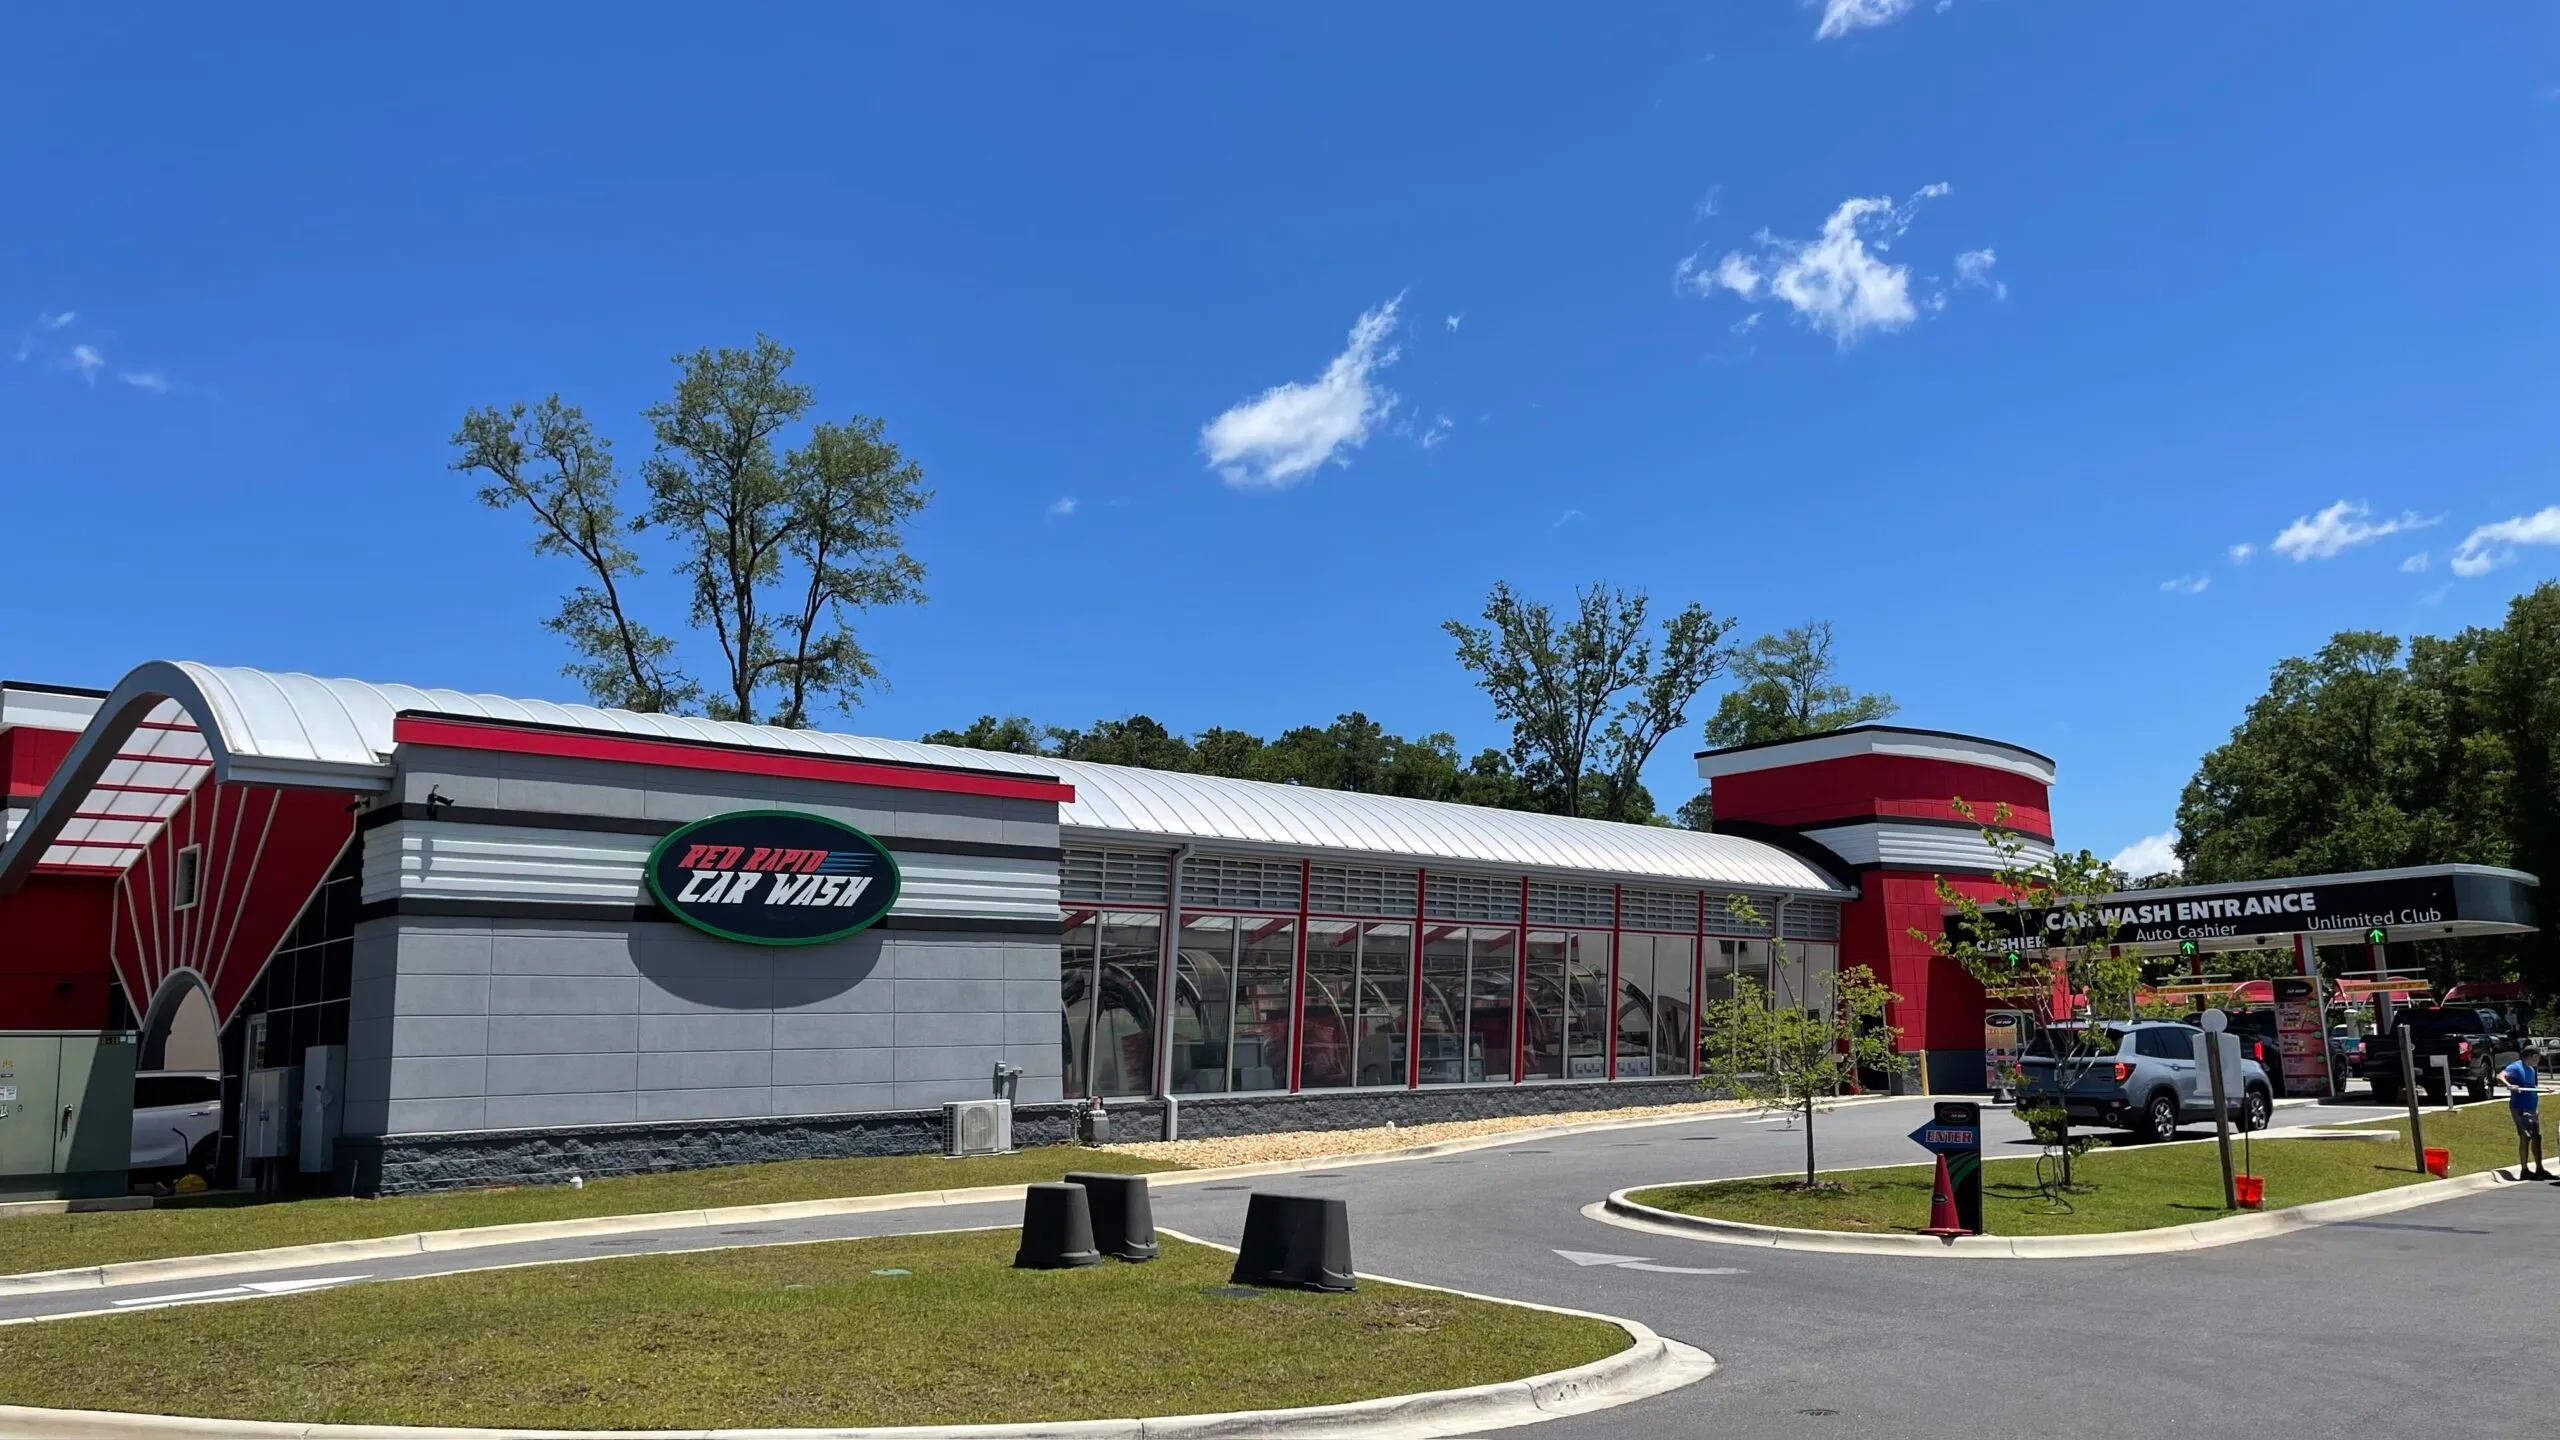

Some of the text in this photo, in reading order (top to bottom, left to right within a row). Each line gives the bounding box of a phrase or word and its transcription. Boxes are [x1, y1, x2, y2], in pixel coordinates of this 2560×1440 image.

[678, 845, 829, 872] RED RAPID
[677, 870, 873, 907] CAR WASH
[2046, 892, 2316, 931] CAR WASH ENTRANCE
[2307, 908, 2441, 930] Unlimited Club
[2136, 922, 2237, 941] Auto Cashier
[1976, 936, 2046, 952] CASHIER
[1926, 1129, 1972, 1144] ENTER
